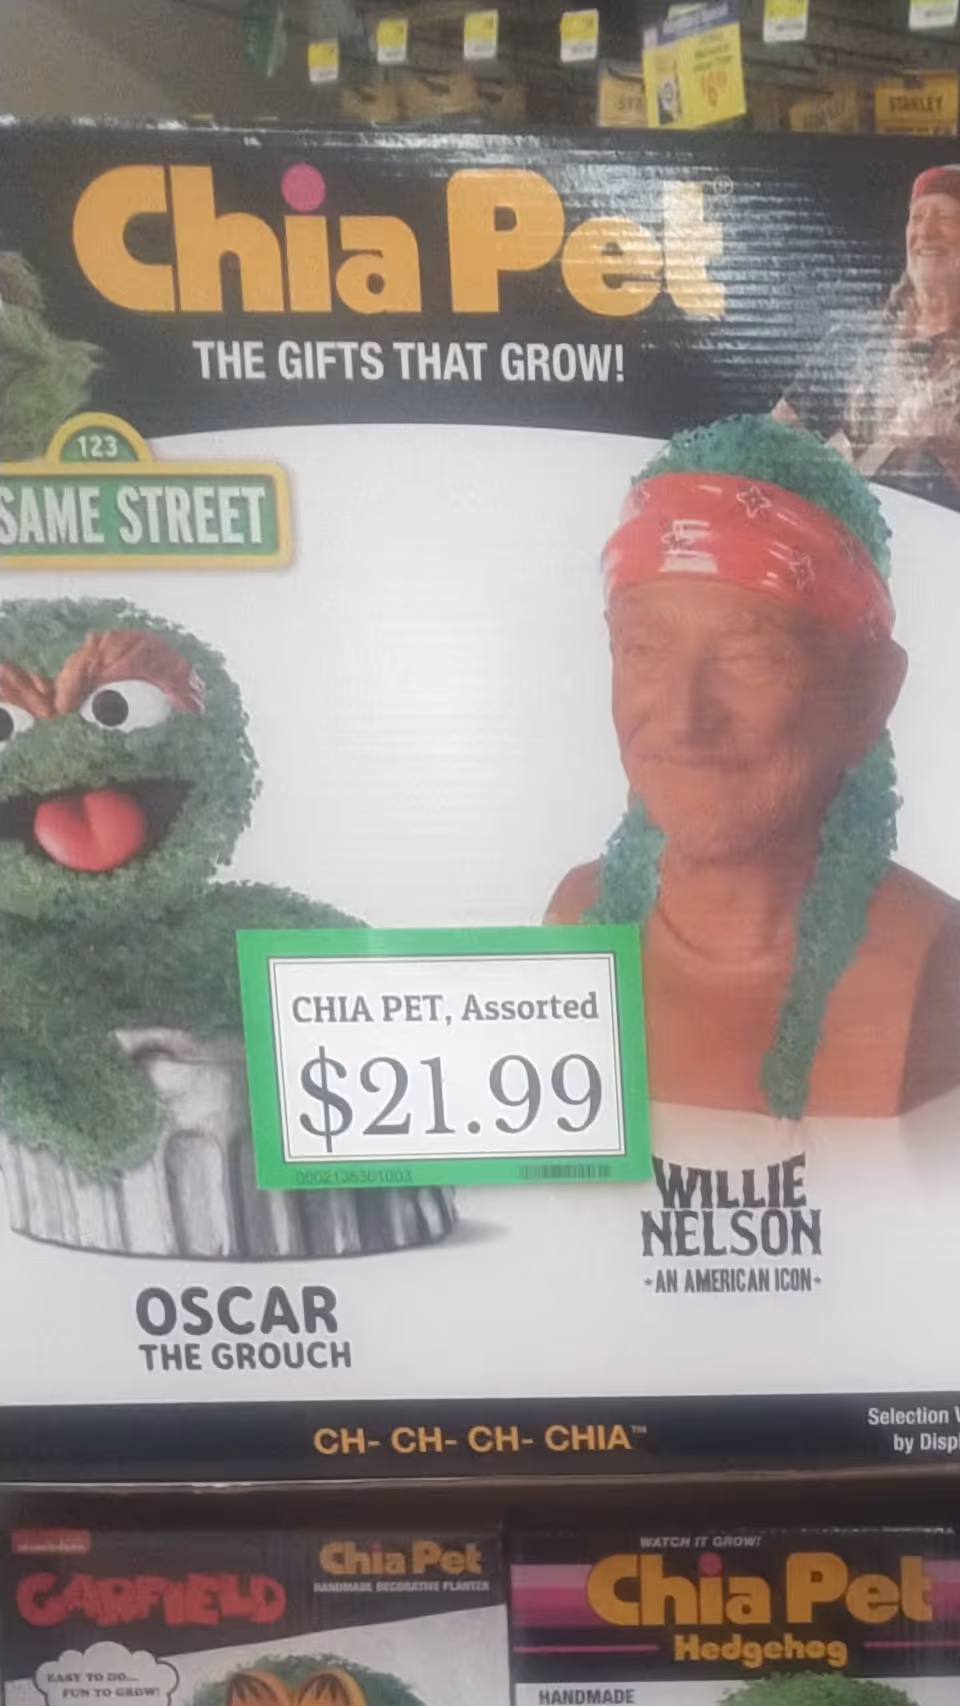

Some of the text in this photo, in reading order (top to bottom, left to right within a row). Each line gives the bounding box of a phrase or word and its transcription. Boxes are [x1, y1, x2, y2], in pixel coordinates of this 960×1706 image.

[72, 162, 727, 318] Chia Pet
[193, 340, 625, 383] THE GIFTS THAT GROW!
[77, 435, 118, 458] 123
[116, 486, 267, 545] STREET
[292, 991, 600, 1026] CHIA PET, Assorted
[300, 1045, 602, 1153] $21.99
[652, 1154, 807, 1208] WILLIE
[641, 1208, 823, 1258] NELSON
[682, 1268, 771, 1293] AMERICAN
[775, 1267, 812, 1291] ICON
[135, 1285, 338, 1336] OSCAR
[138, 1340, 352, 1371] THE GROUCH
[867, 1406, 950, 1426] Selection
[313, 1427, 380, 1455] CH-
[391, 1426, 457, 1453] CH-
[467, 1425, 534, 1452] CH-
[893, 1434, 914, 1454] by
[320, 1540, 483, 1576] Chia Pet
[640, 1536, 761, 1548] WATCH IT GROW!
[17, 1572, 287, 1627] GARFIELD
[314, 1582, 371, 1593] HANDMADE
[443, 1581, 490, 1592] PLANTER
[586, 1551, 933, 1626] Chia Pet
[674, 1633, 848, 1669] Hedgehog
[47, 1672, 80, 1683] EASY
[86, 1672, 103, 1683] TO
[62, 1686, 160, 1699] FUN TO GROW!
[539, 1689, 635, 1705] HANDMADE
